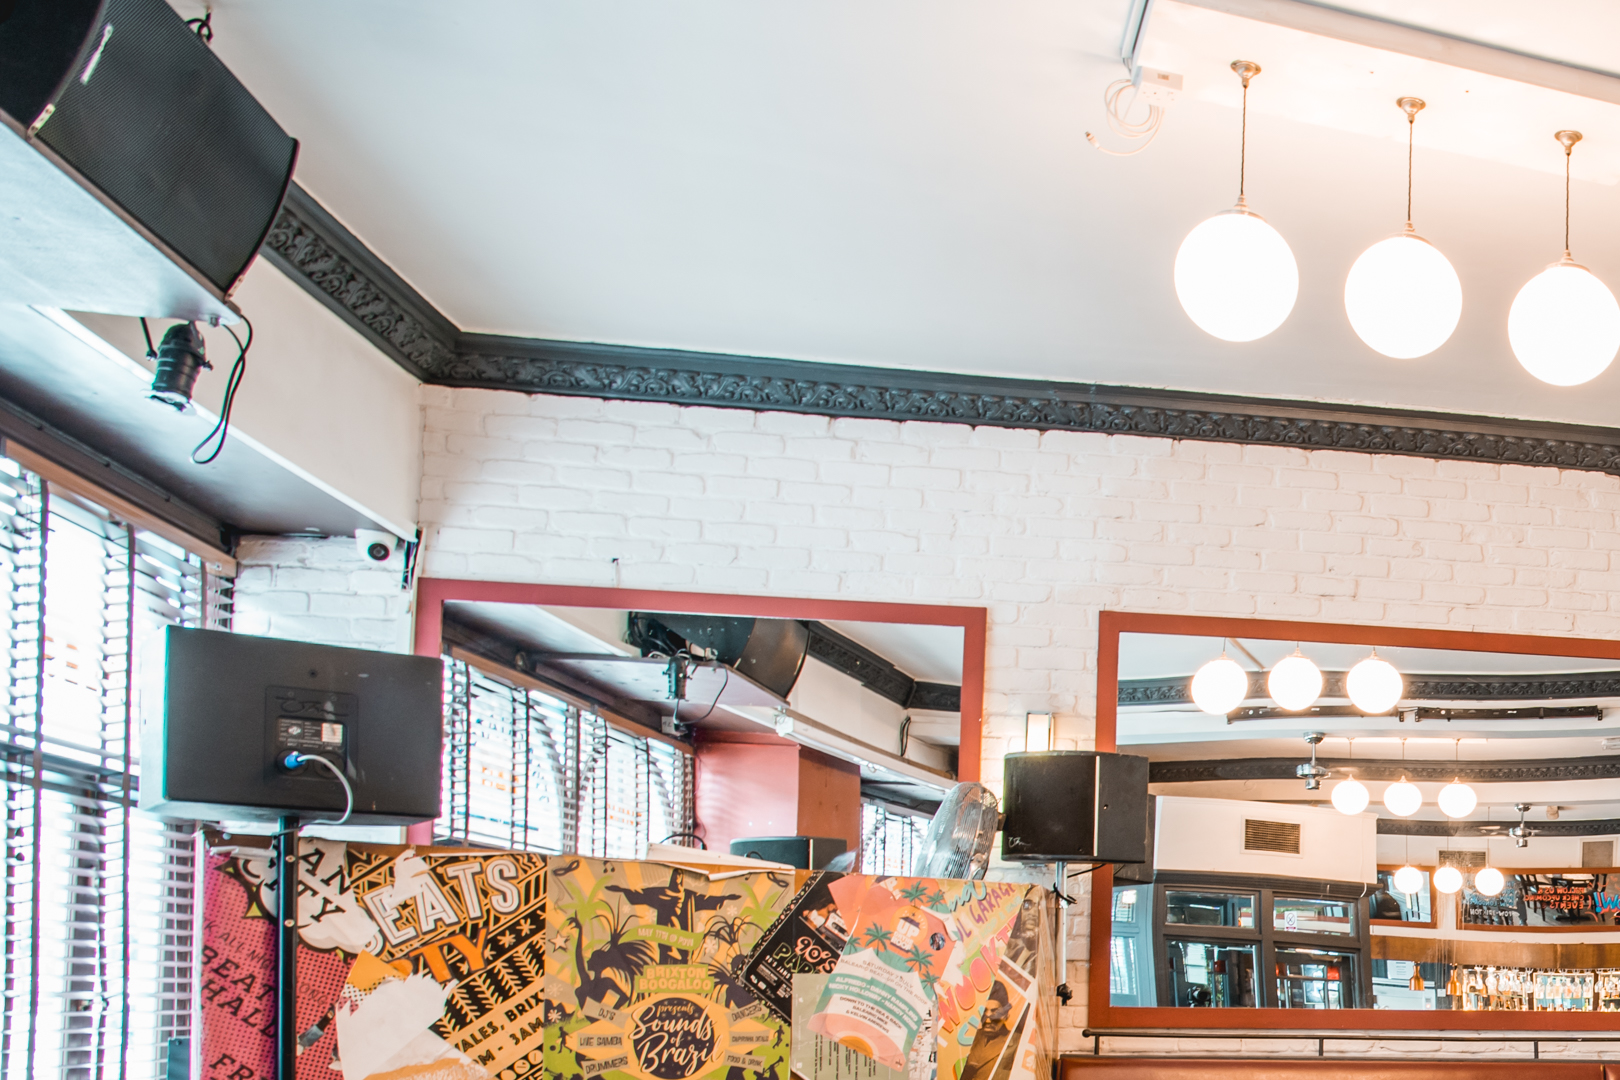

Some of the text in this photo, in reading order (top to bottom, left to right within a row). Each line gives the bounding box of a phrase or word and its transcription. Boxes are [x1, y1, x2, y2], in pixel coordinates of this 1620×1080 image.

[896, 918, 920, 938] UP
[646, 965, 706, 979] BRIXTON
[639, 978, 711, 990] BOOGALOO
[656, 1002, 696, 1017] presents
[628, 1004, 718, 1041] Sounds
[596, 1036, 622, 1046] SAMBA
[670, 1030, 684, 1047] of
[637, 1032, 724, 1077] Brazil
[585, 1056, 629, 1074] DRUMMERS
